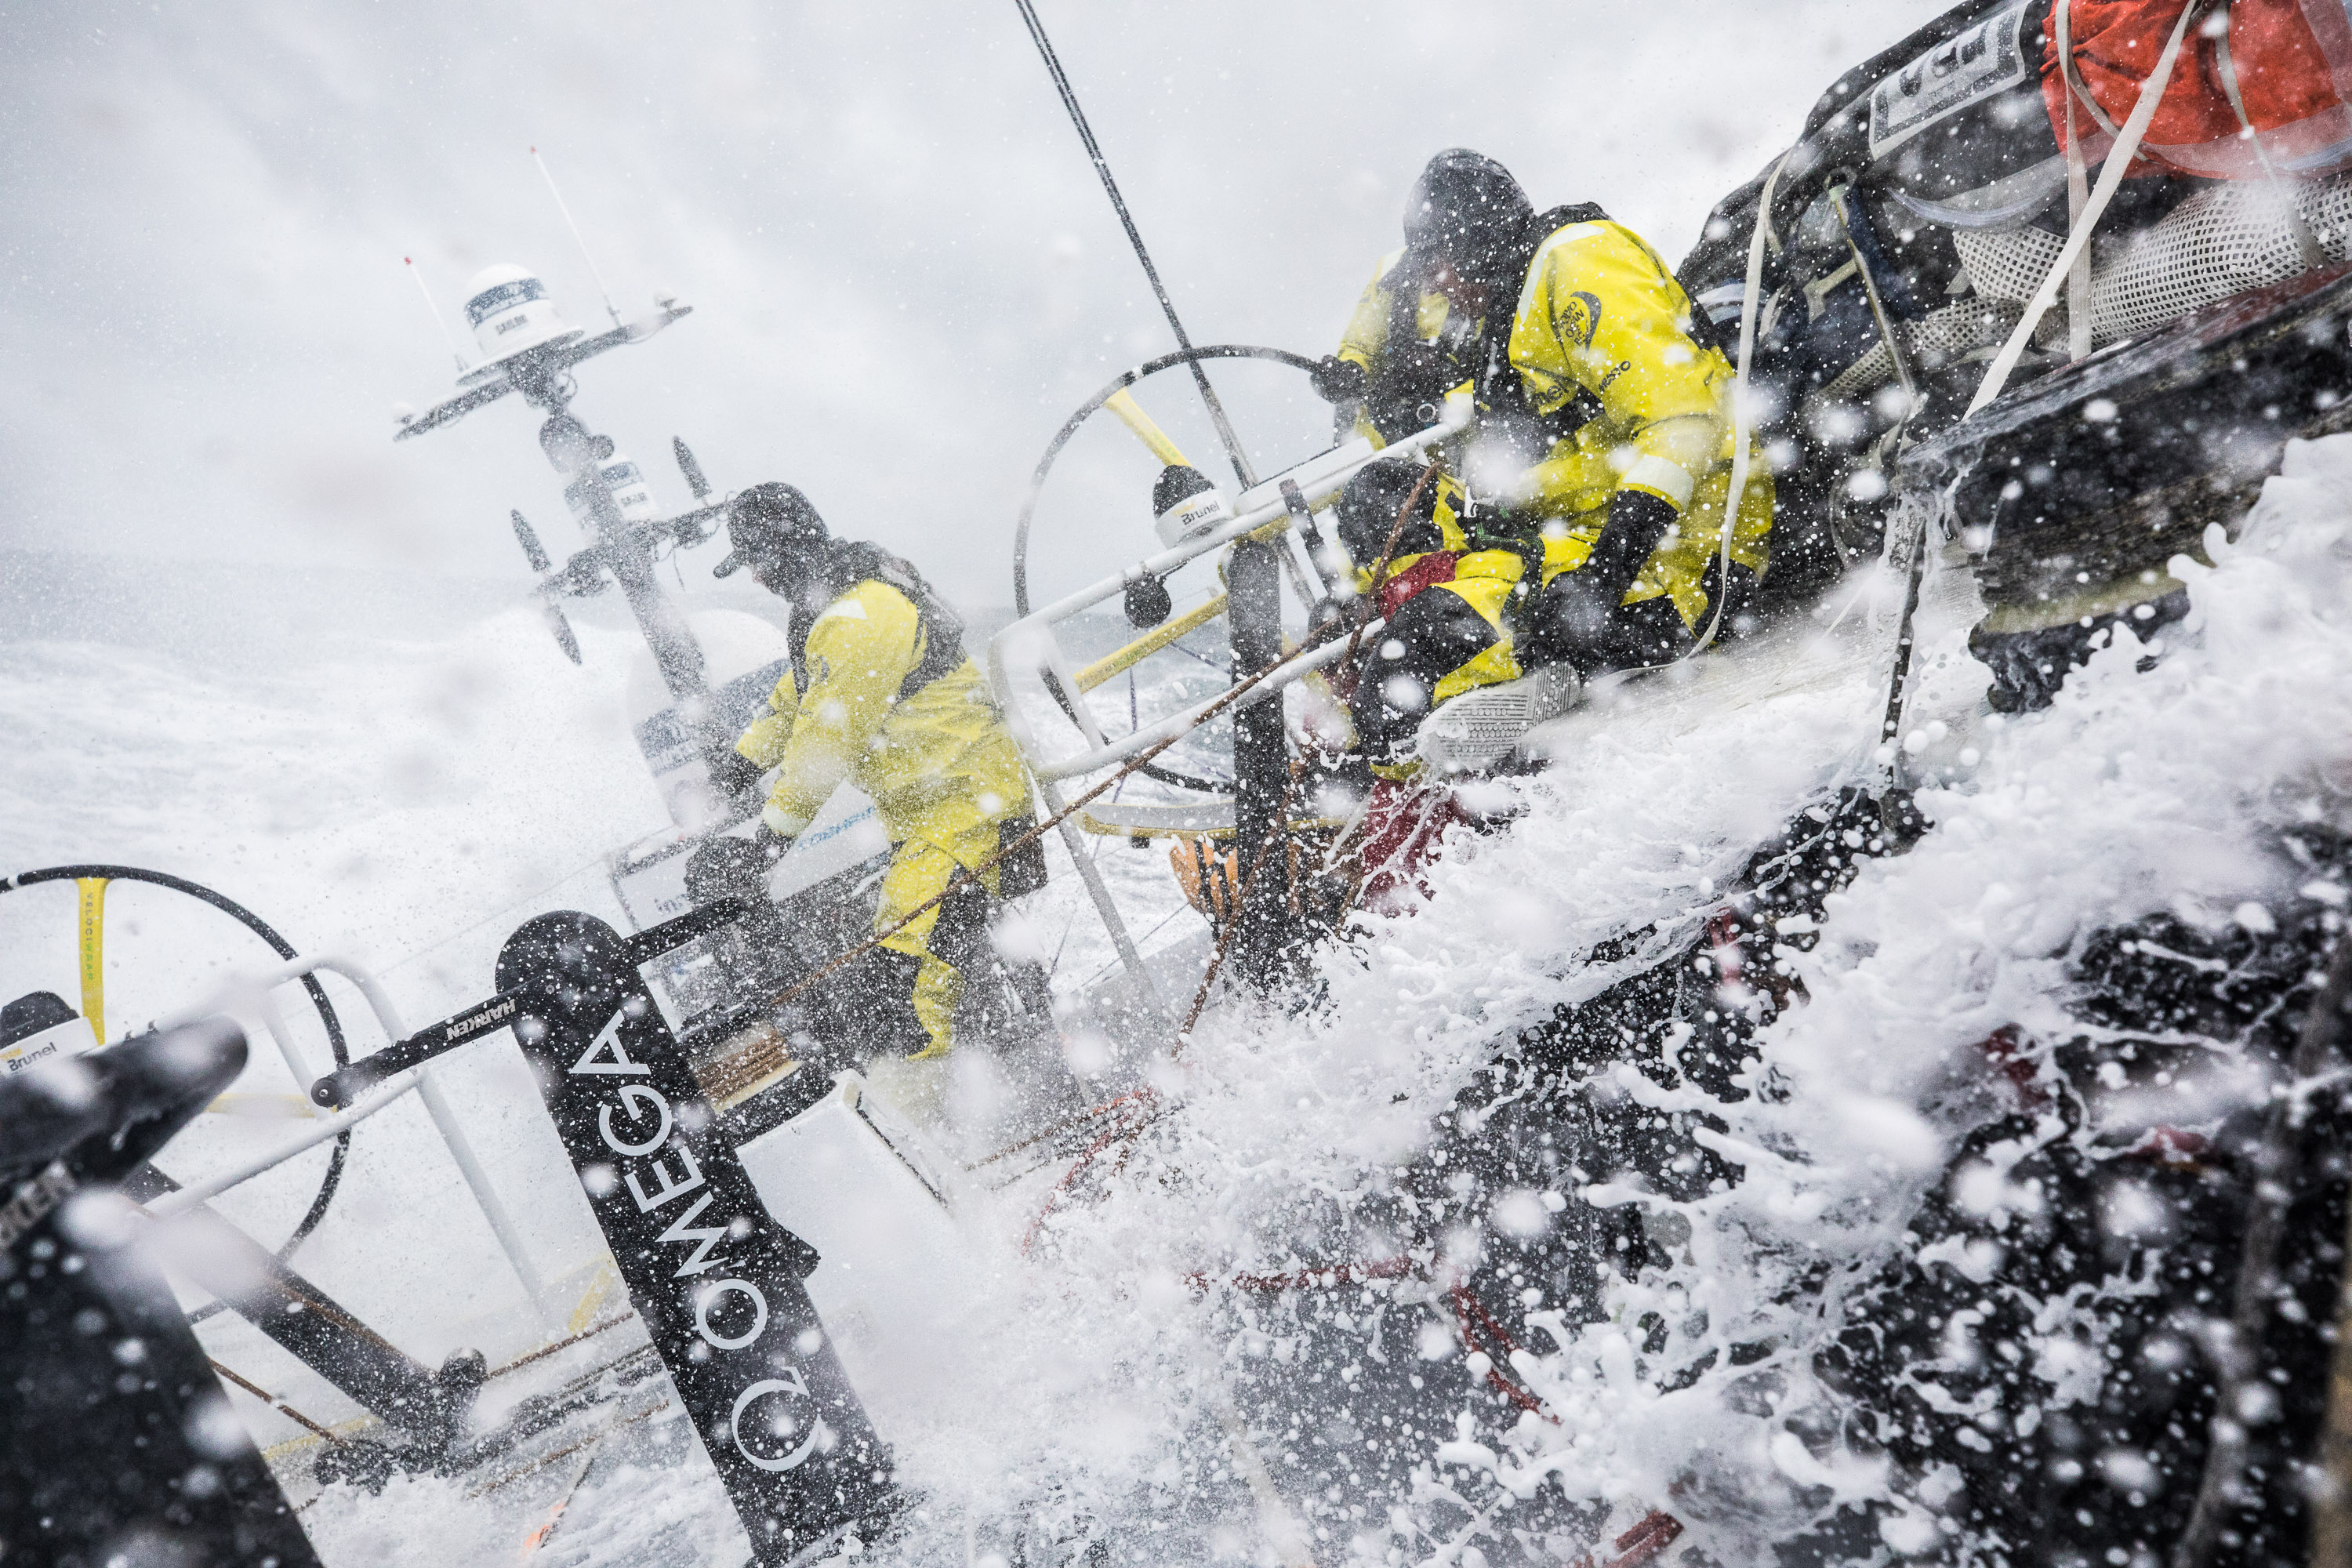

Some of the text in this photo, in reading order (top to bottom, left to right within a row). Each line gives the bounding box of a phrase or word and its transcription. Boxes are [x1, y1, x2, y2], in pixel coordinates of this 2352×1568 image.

[1598, 361, 1631, 393] MUSTO
[1181, 500, 1220, 525] Brunel
[446, 998, 516, 1041] HARKEN
[7, 1041, 57, 1072] Brunel
[570, 1009, 768, 1351] OMEGA
